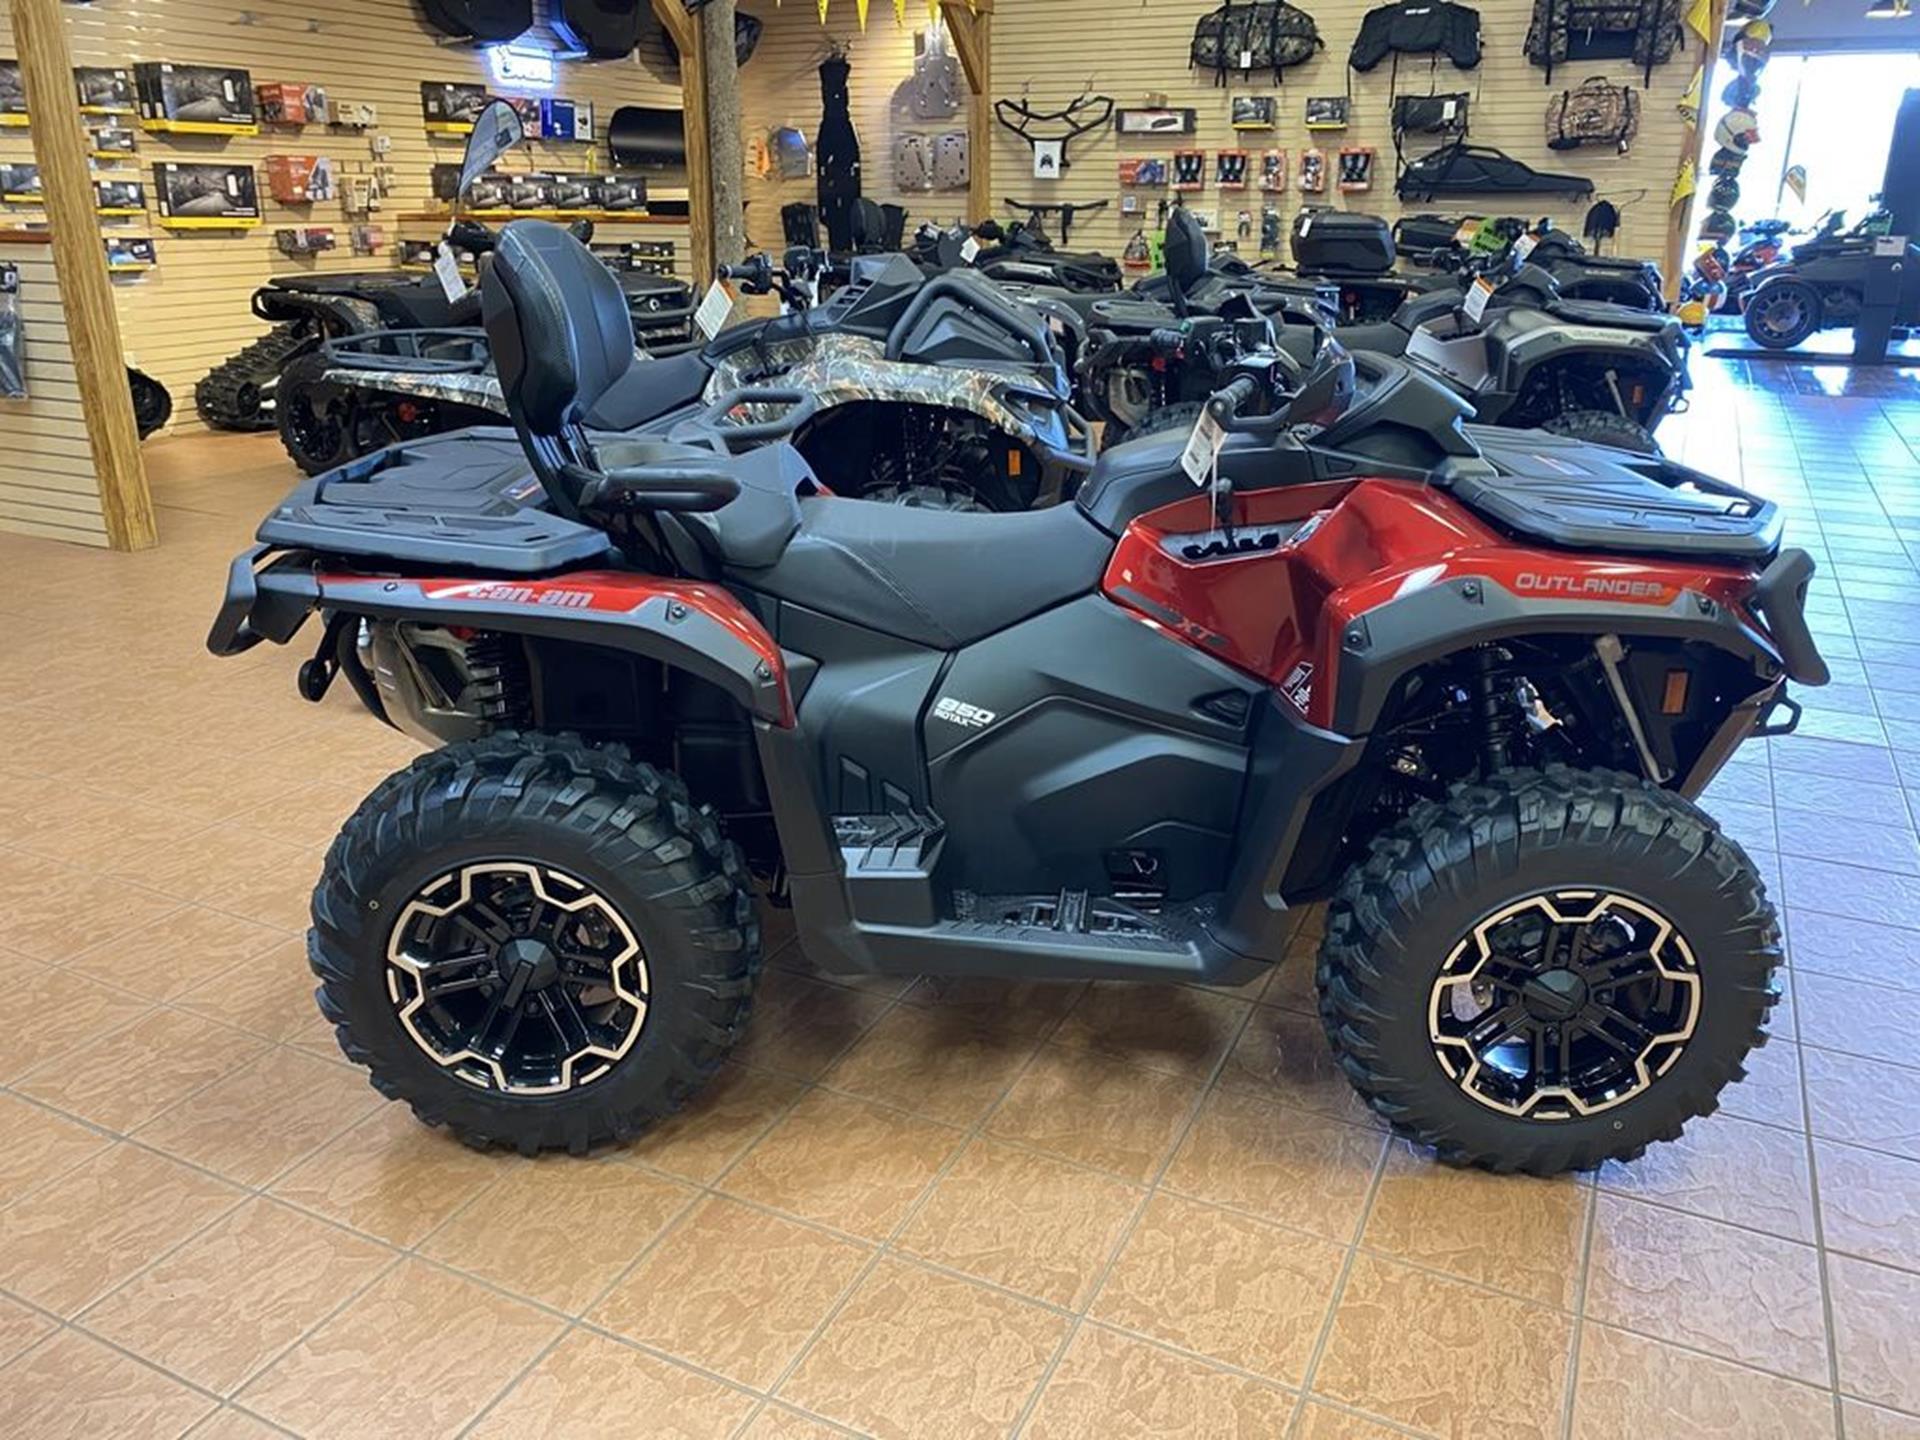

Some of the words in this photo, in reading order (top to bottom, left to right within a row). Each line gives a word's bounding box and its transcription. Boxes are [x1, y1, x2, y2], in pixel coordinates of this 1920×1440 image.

[1515, 574, 1663, 596] OUTLANDER
[934, 708, 968, 727] ROTAX
[938, 697, 995, 724] 850
